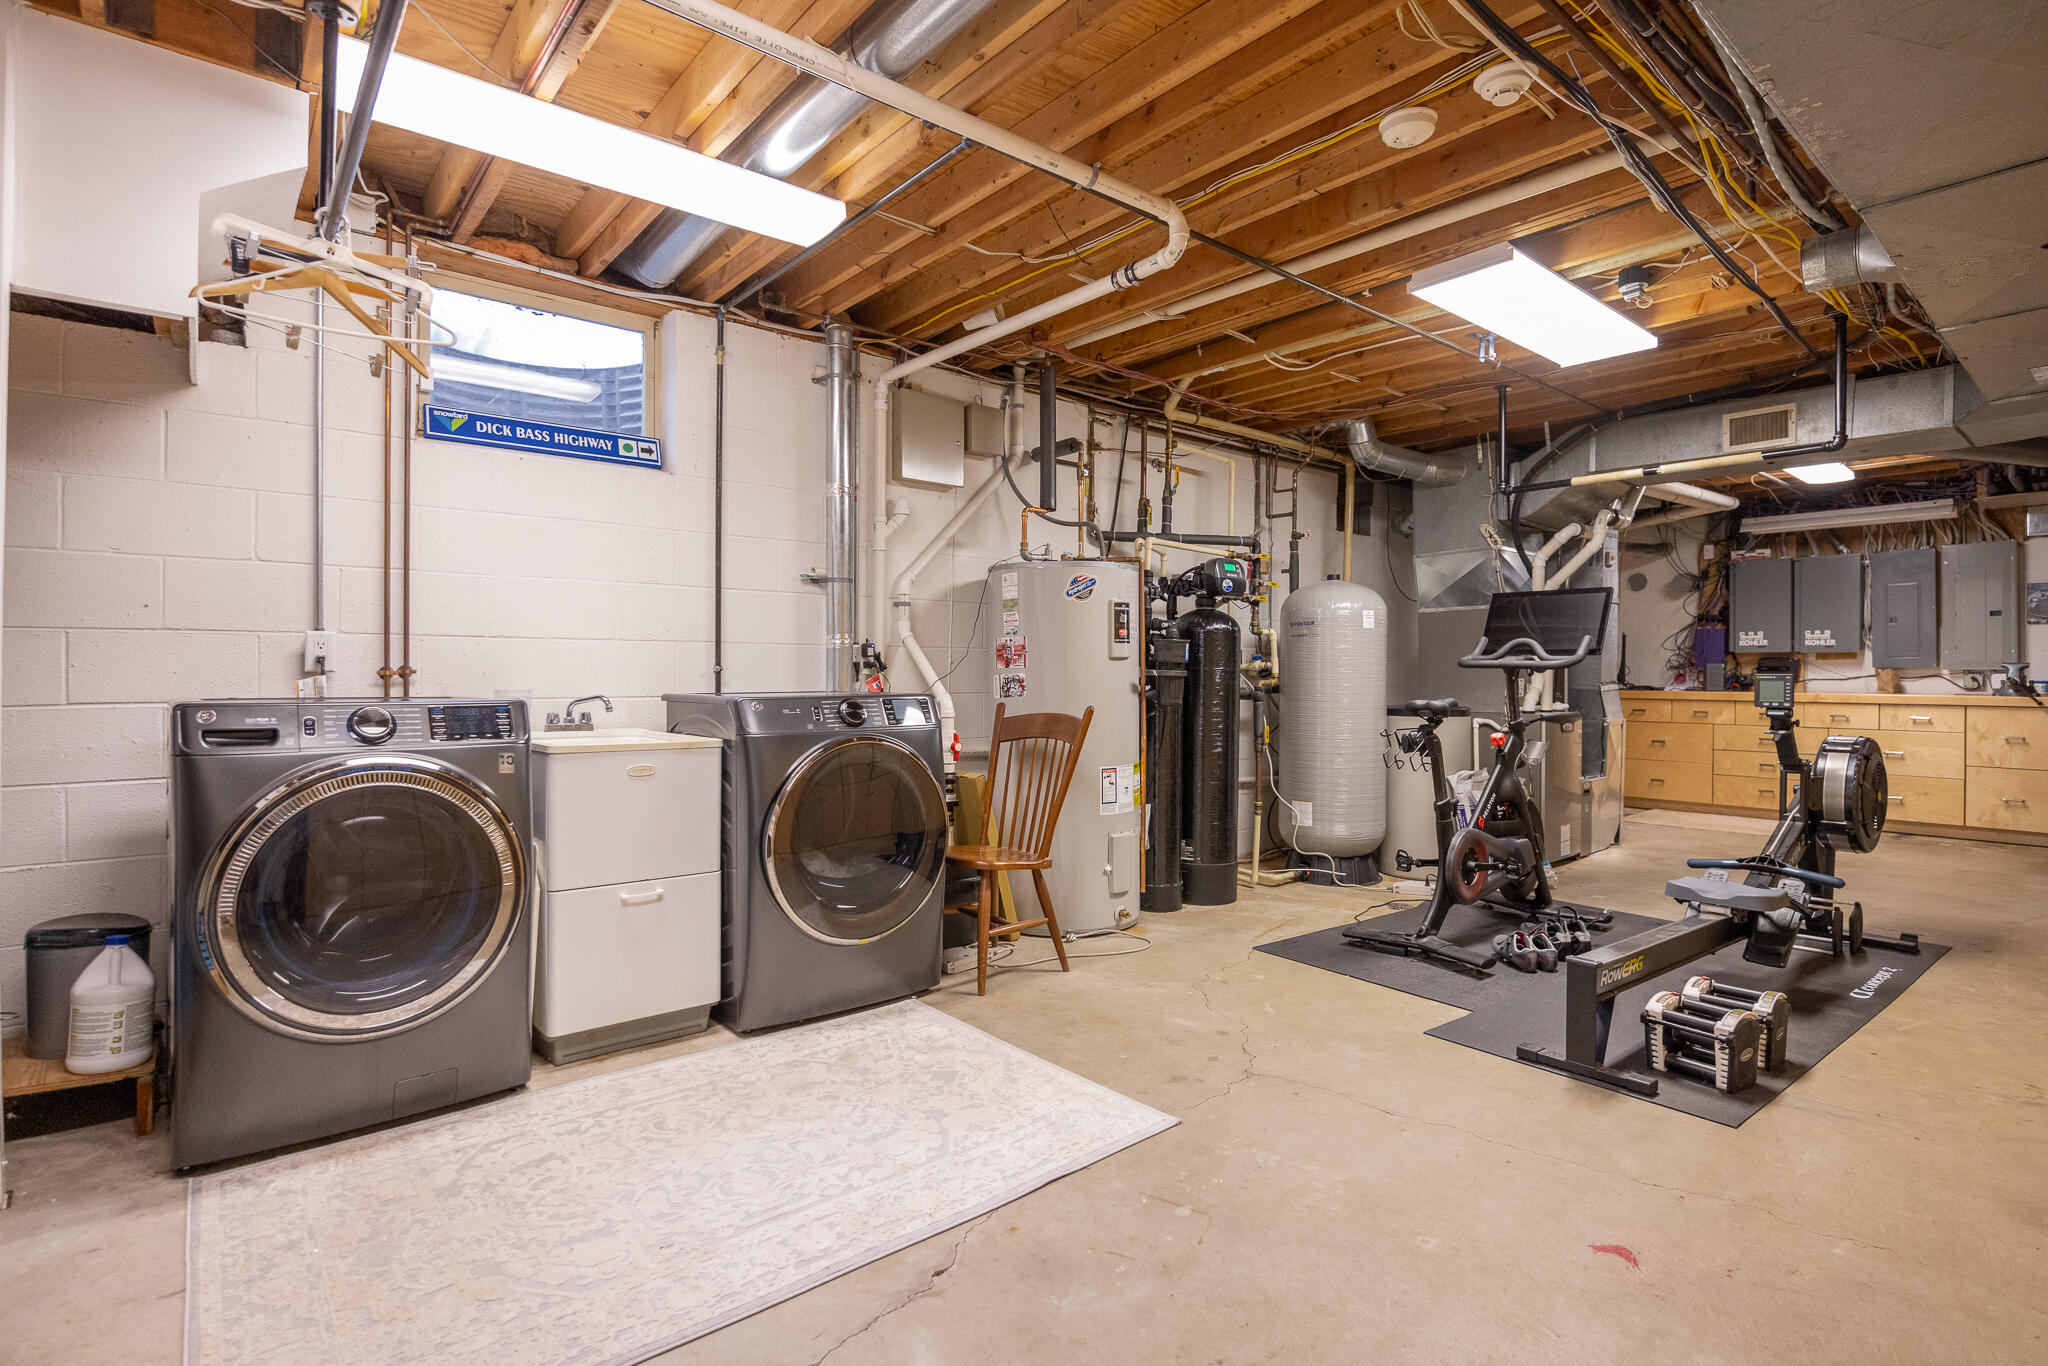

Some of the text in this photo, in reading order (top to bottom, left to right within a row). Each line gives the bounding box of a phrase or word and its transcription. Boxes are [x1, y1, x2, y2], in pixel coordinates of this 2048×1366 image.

[719, 19, 816, 66] CHARLOTTE PIPE
[433, 409, 469, 420] snowbird
[476, 420, 614, 451] DICK BASS HIGHWAY
[1804, 638, 1837, 646] KOHLER
[1482, 792, 1497, 820] PELOTON
